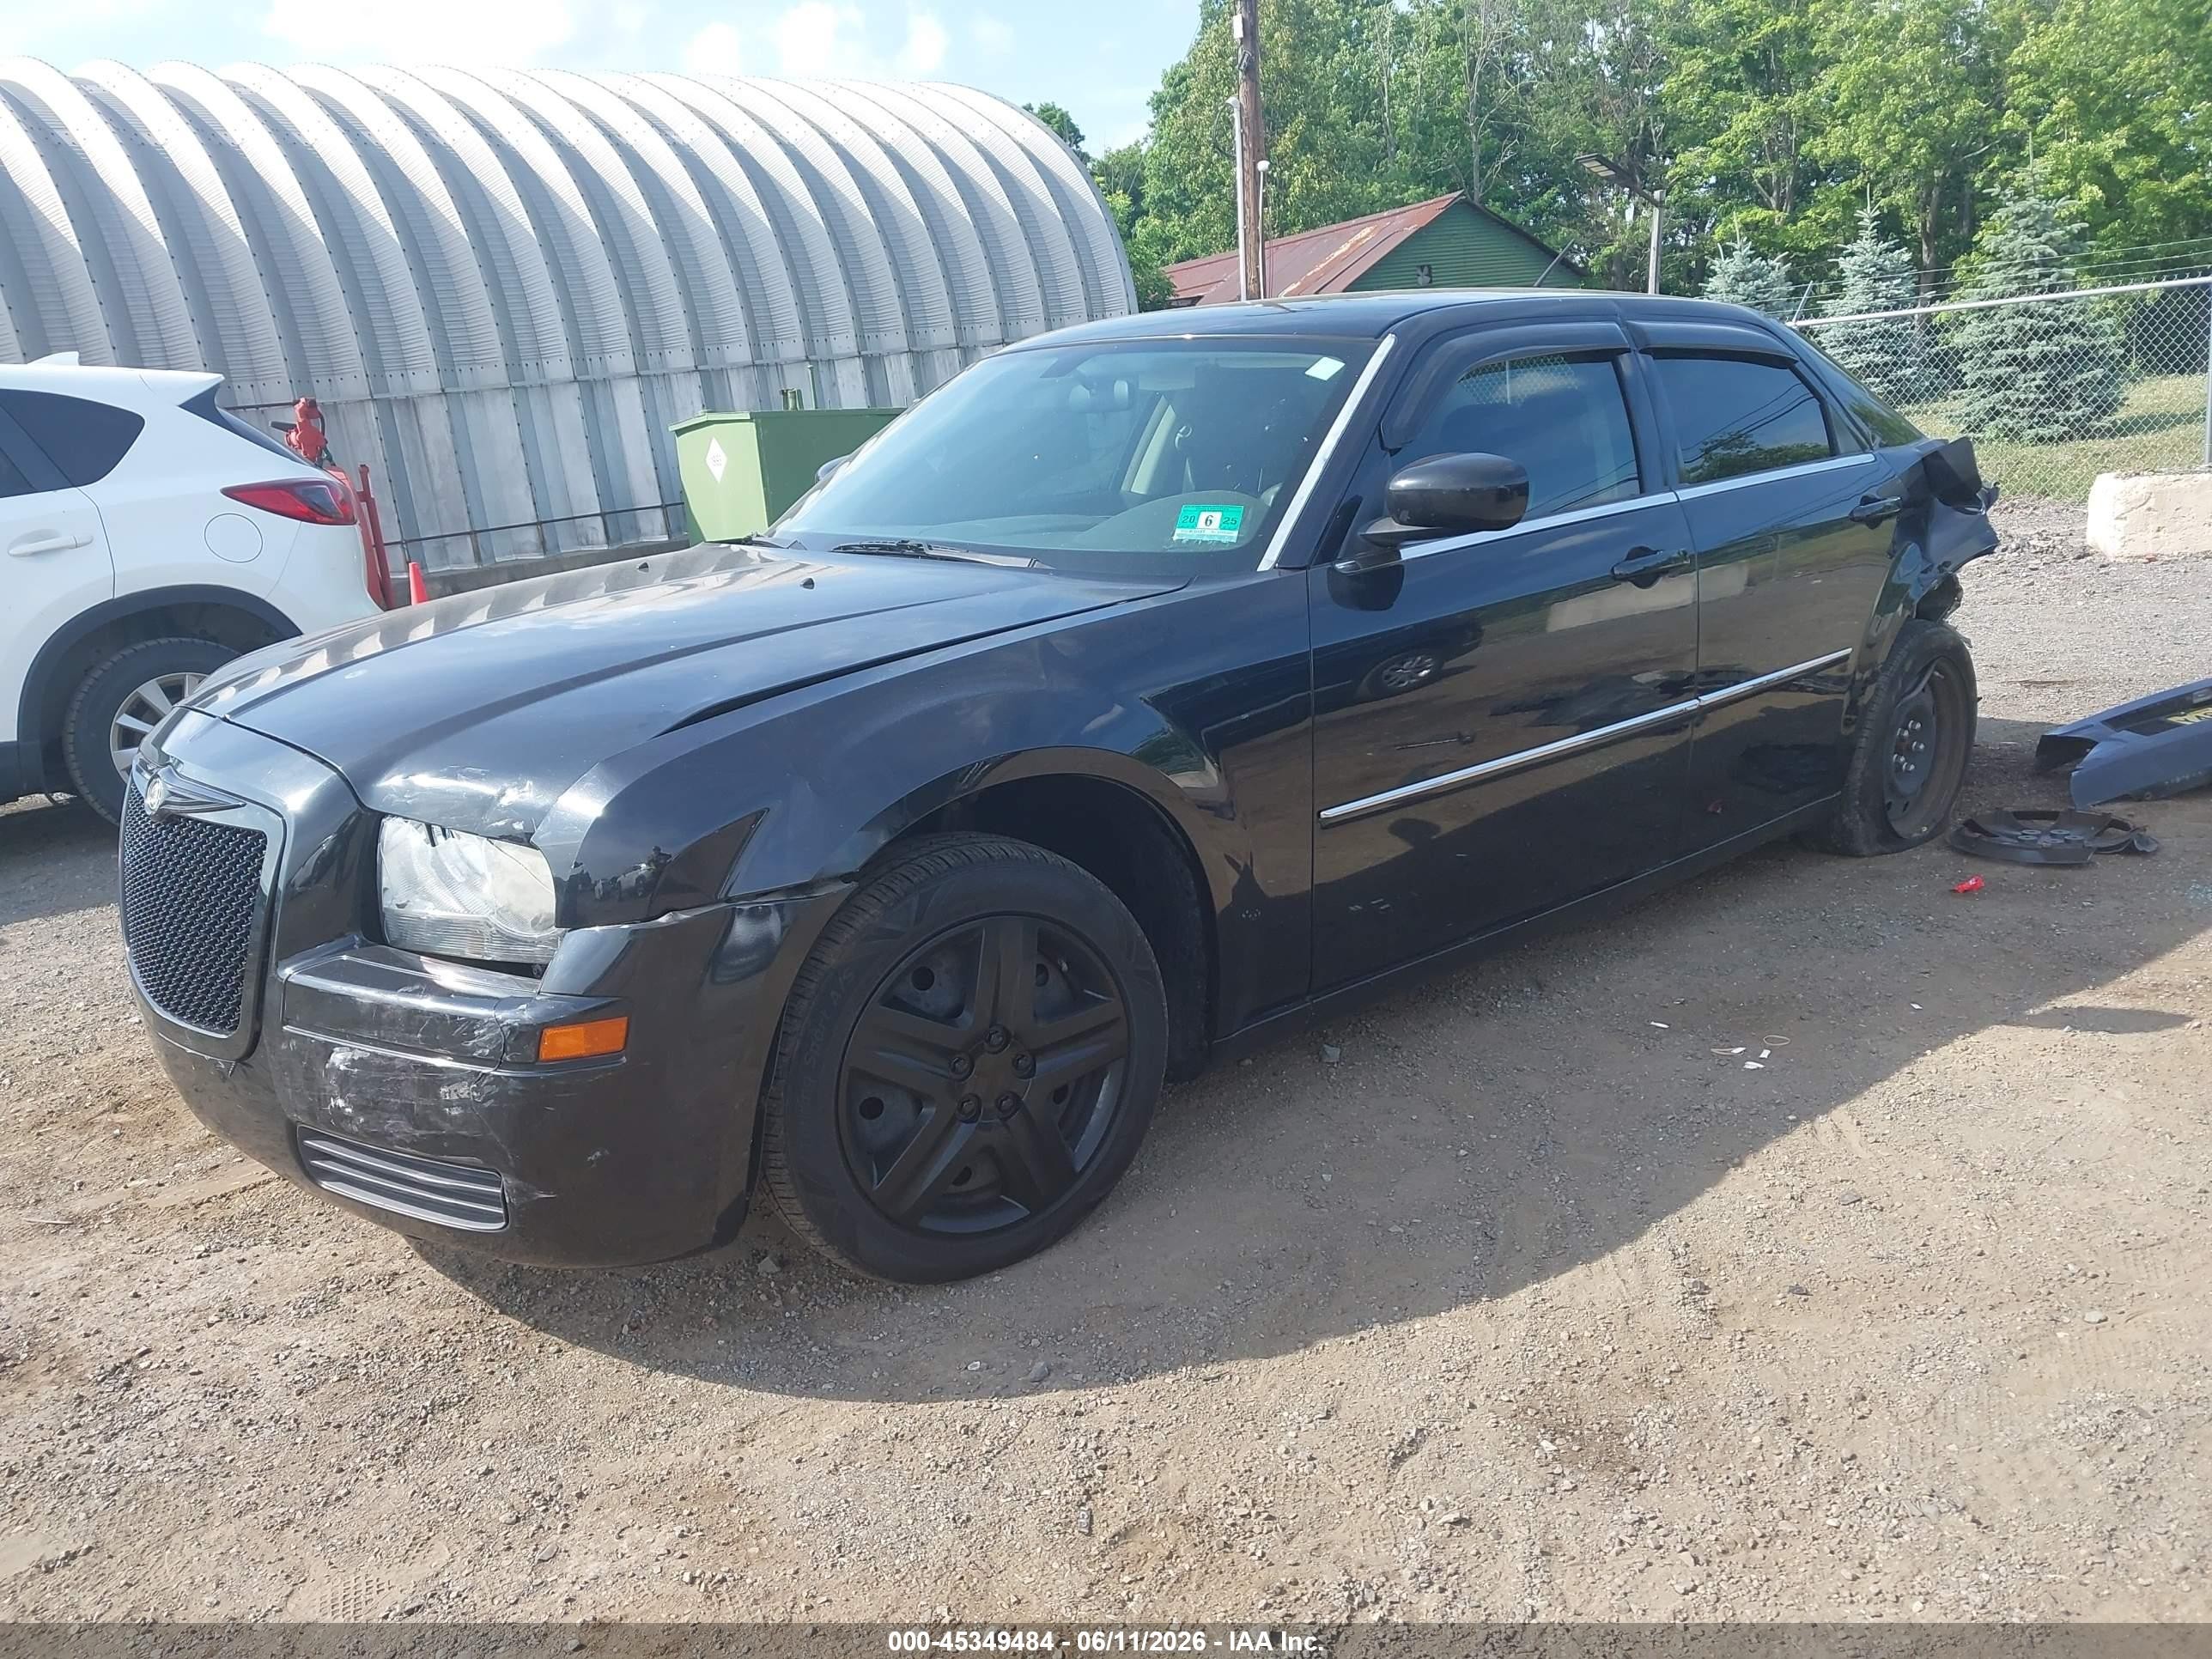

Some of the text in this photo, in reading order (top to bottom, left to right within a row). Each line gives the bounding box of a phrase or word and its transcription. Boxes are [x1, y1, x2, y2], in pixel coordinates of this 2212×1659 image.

[1181, 514, 1237, 527] 20 6 25
